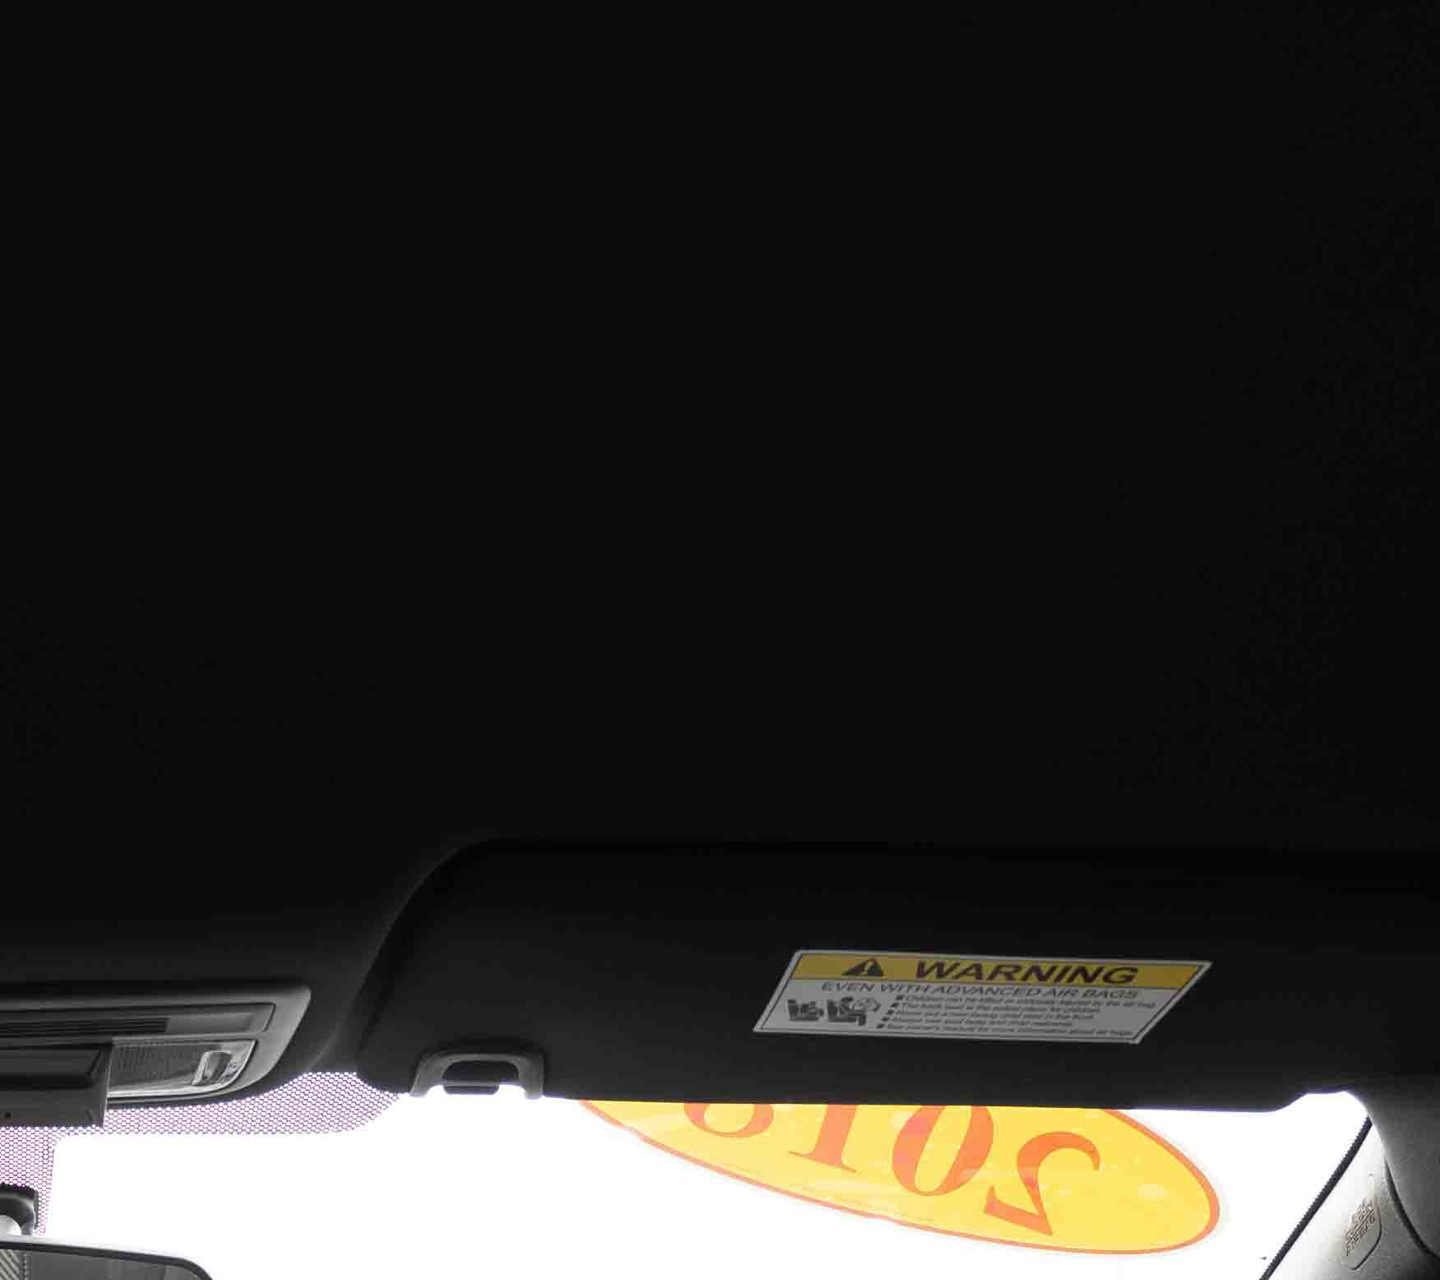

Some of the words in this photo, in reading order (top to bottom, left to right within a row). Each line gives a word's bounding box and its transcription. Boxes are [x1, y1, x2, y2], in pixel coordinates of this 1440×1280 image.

[915, 960, 1139, 984] WARNING
[822, 982, 875, 992] EVEN
[880, 983, 931, 993] WITH
[931, 985, 1040, 997] ADVANCED
[1044, 988, 1079, 998] AIR
[1081, 989, 1138, 999] BAGS
